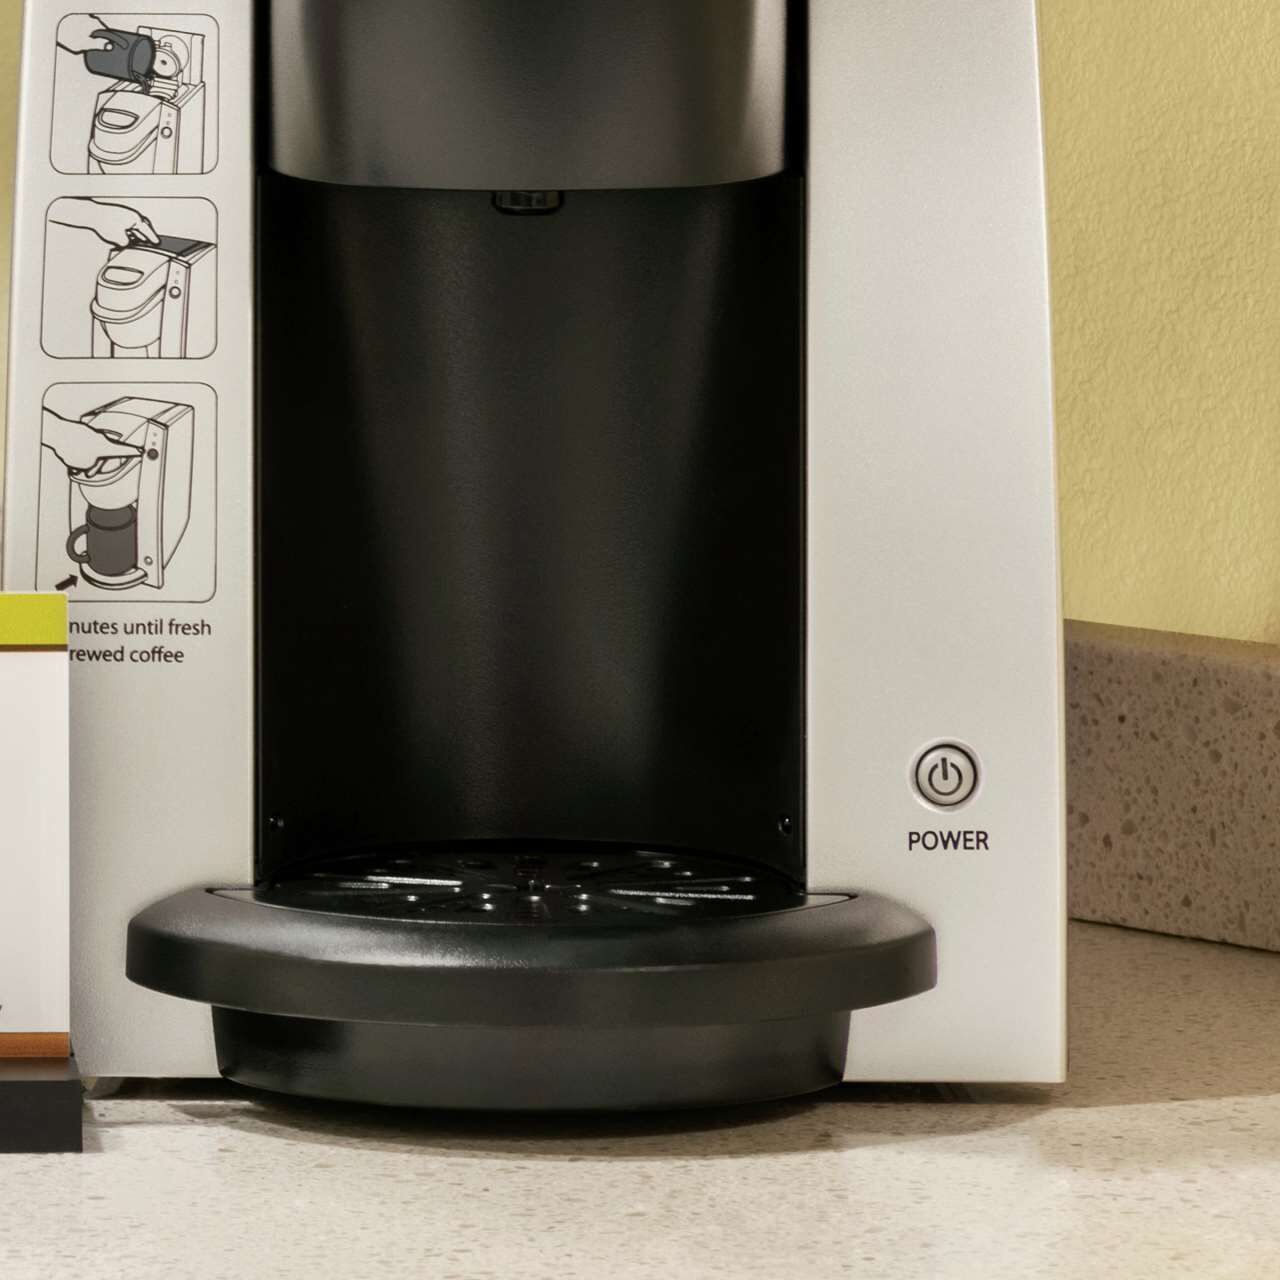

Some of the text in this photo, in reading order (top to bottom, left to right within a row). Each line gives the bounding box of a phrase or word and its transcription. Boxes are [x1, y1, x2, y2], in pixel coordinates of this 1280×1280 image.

[69, 619, 212, 636] nutes until fresh
[69, 646, 185, 663] rewed coffee
[908, 831, 990, 851] POWER
